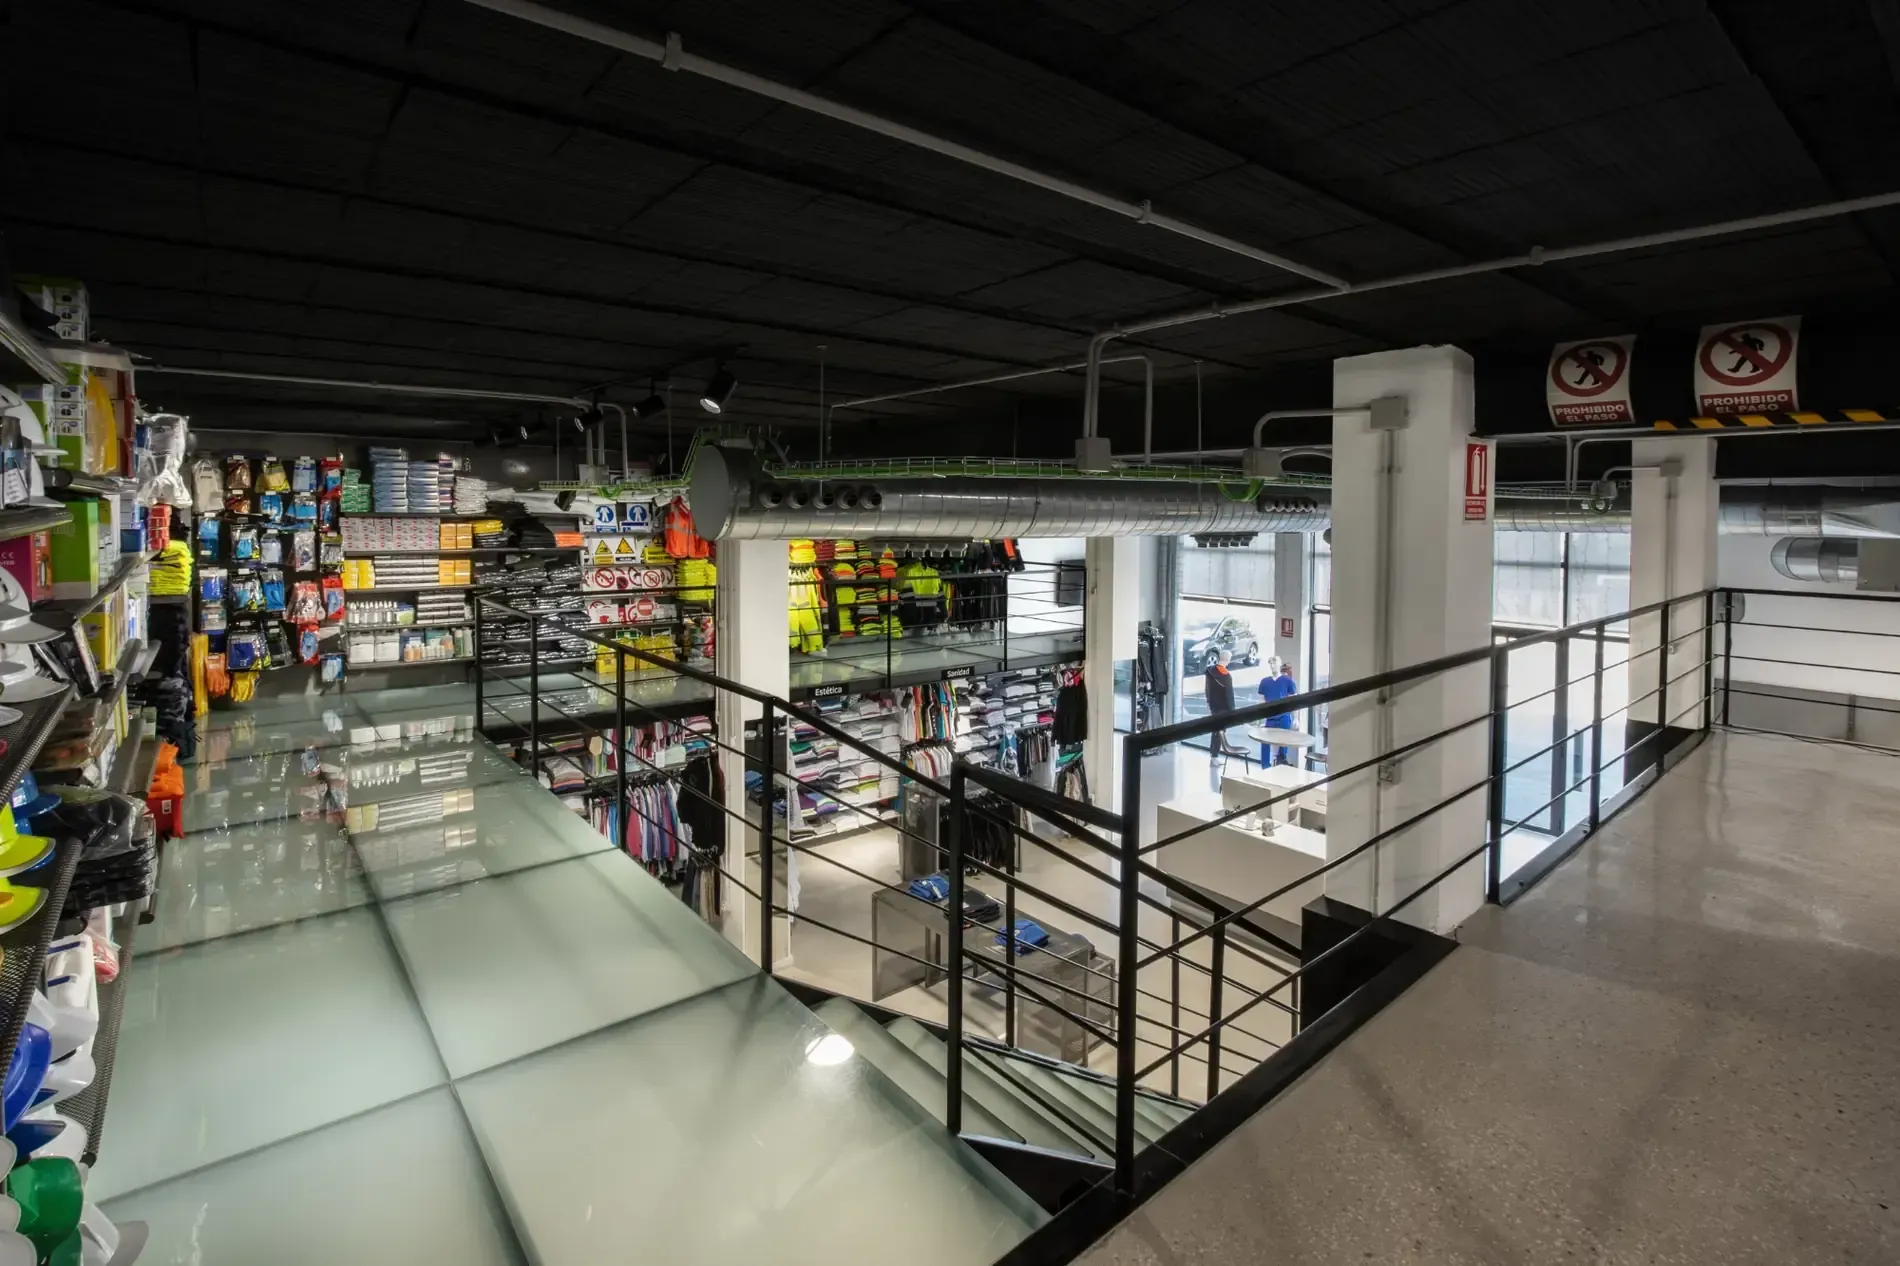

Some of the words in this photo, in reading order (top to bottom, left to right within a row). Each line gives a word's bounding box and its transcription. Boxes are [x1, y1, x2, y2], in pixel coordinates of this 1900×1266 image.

[1703, 393, 1789, 407] PROHIBIDO
[1555, 404, 1625, 416] PROHIBIDO
[1716, 406, 1734, 414] EL
[1738, 403, 1779, 413] PASO
[1584, 413, 1618, 422] PASO
[947, 667, 970, 678] Sanidad
[814, 685, 843, 697] Estética
